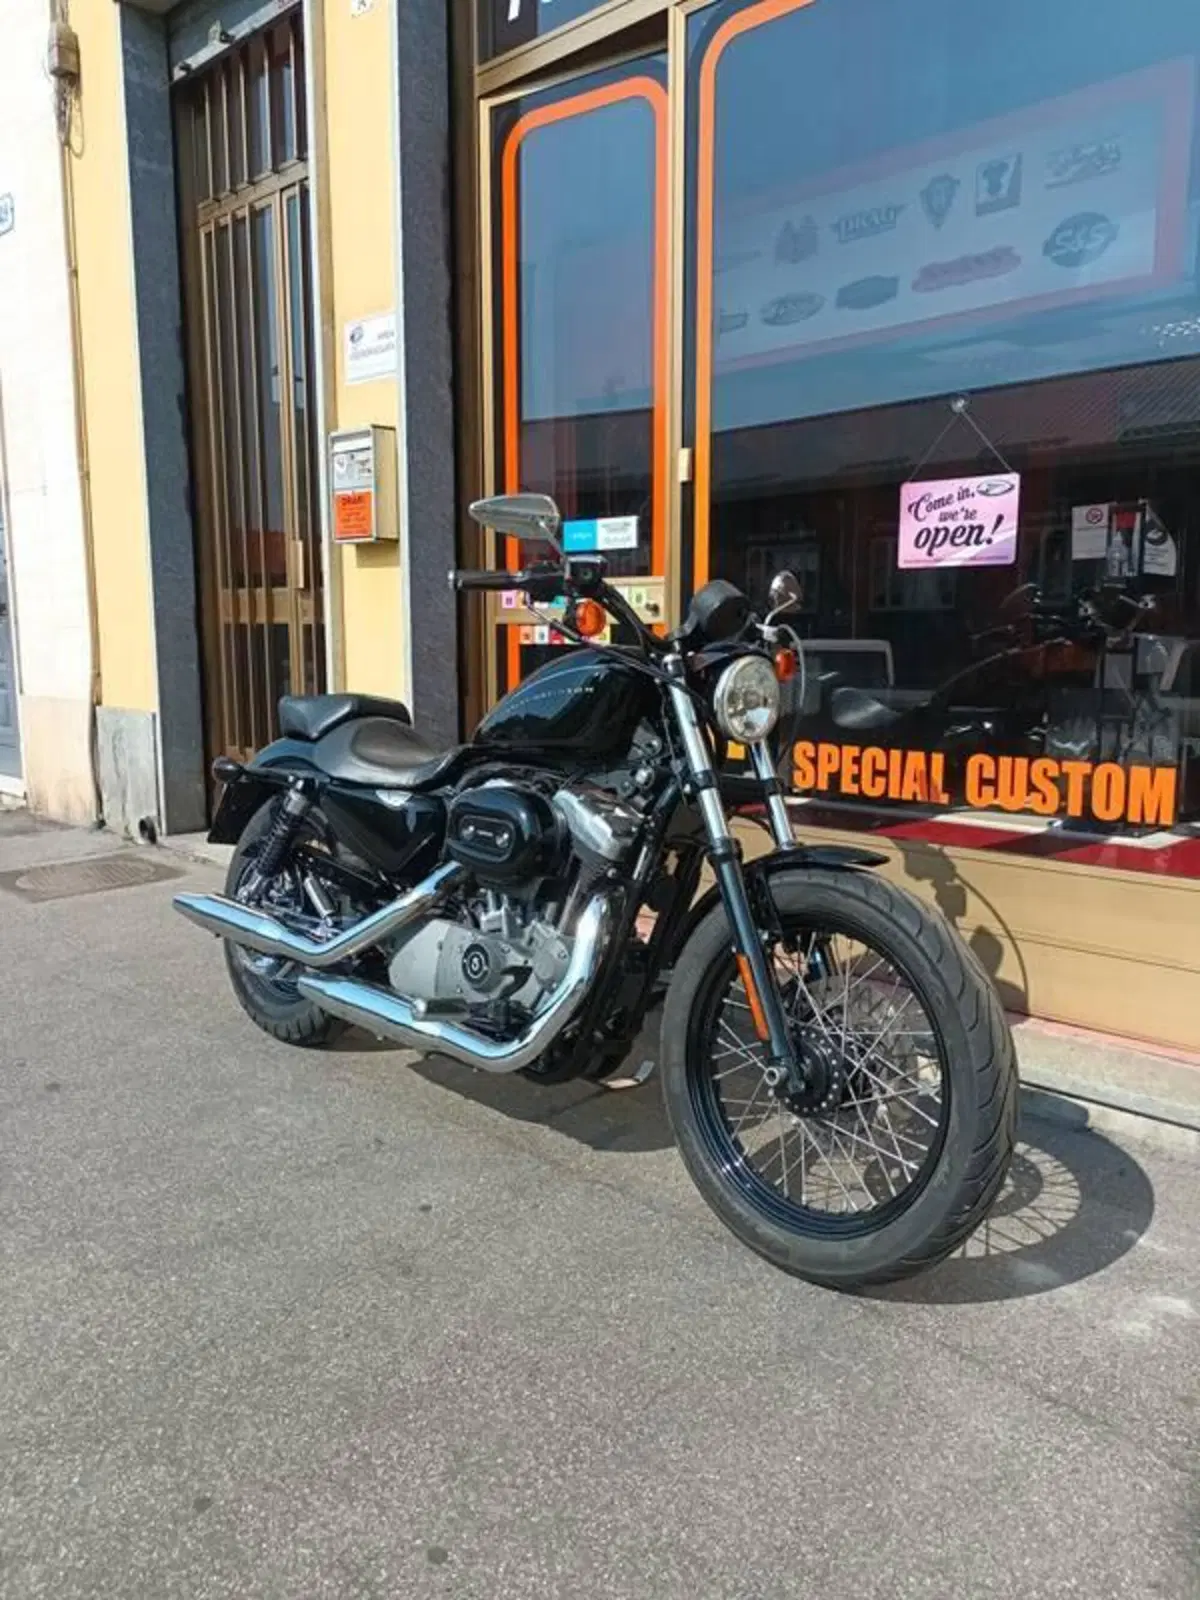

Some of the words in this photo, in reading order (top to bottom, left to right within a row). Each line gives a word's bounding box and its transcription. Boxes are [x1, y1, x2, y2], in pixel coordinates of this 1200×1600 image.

[908, 493, 954, 522] Come
[938, 507, 978, 522] we're
[914, 514, 1005, 557] open!
[793, 741, 949, 804] SPECIAL
[965, 753, 1177, 826] CUSTOM
